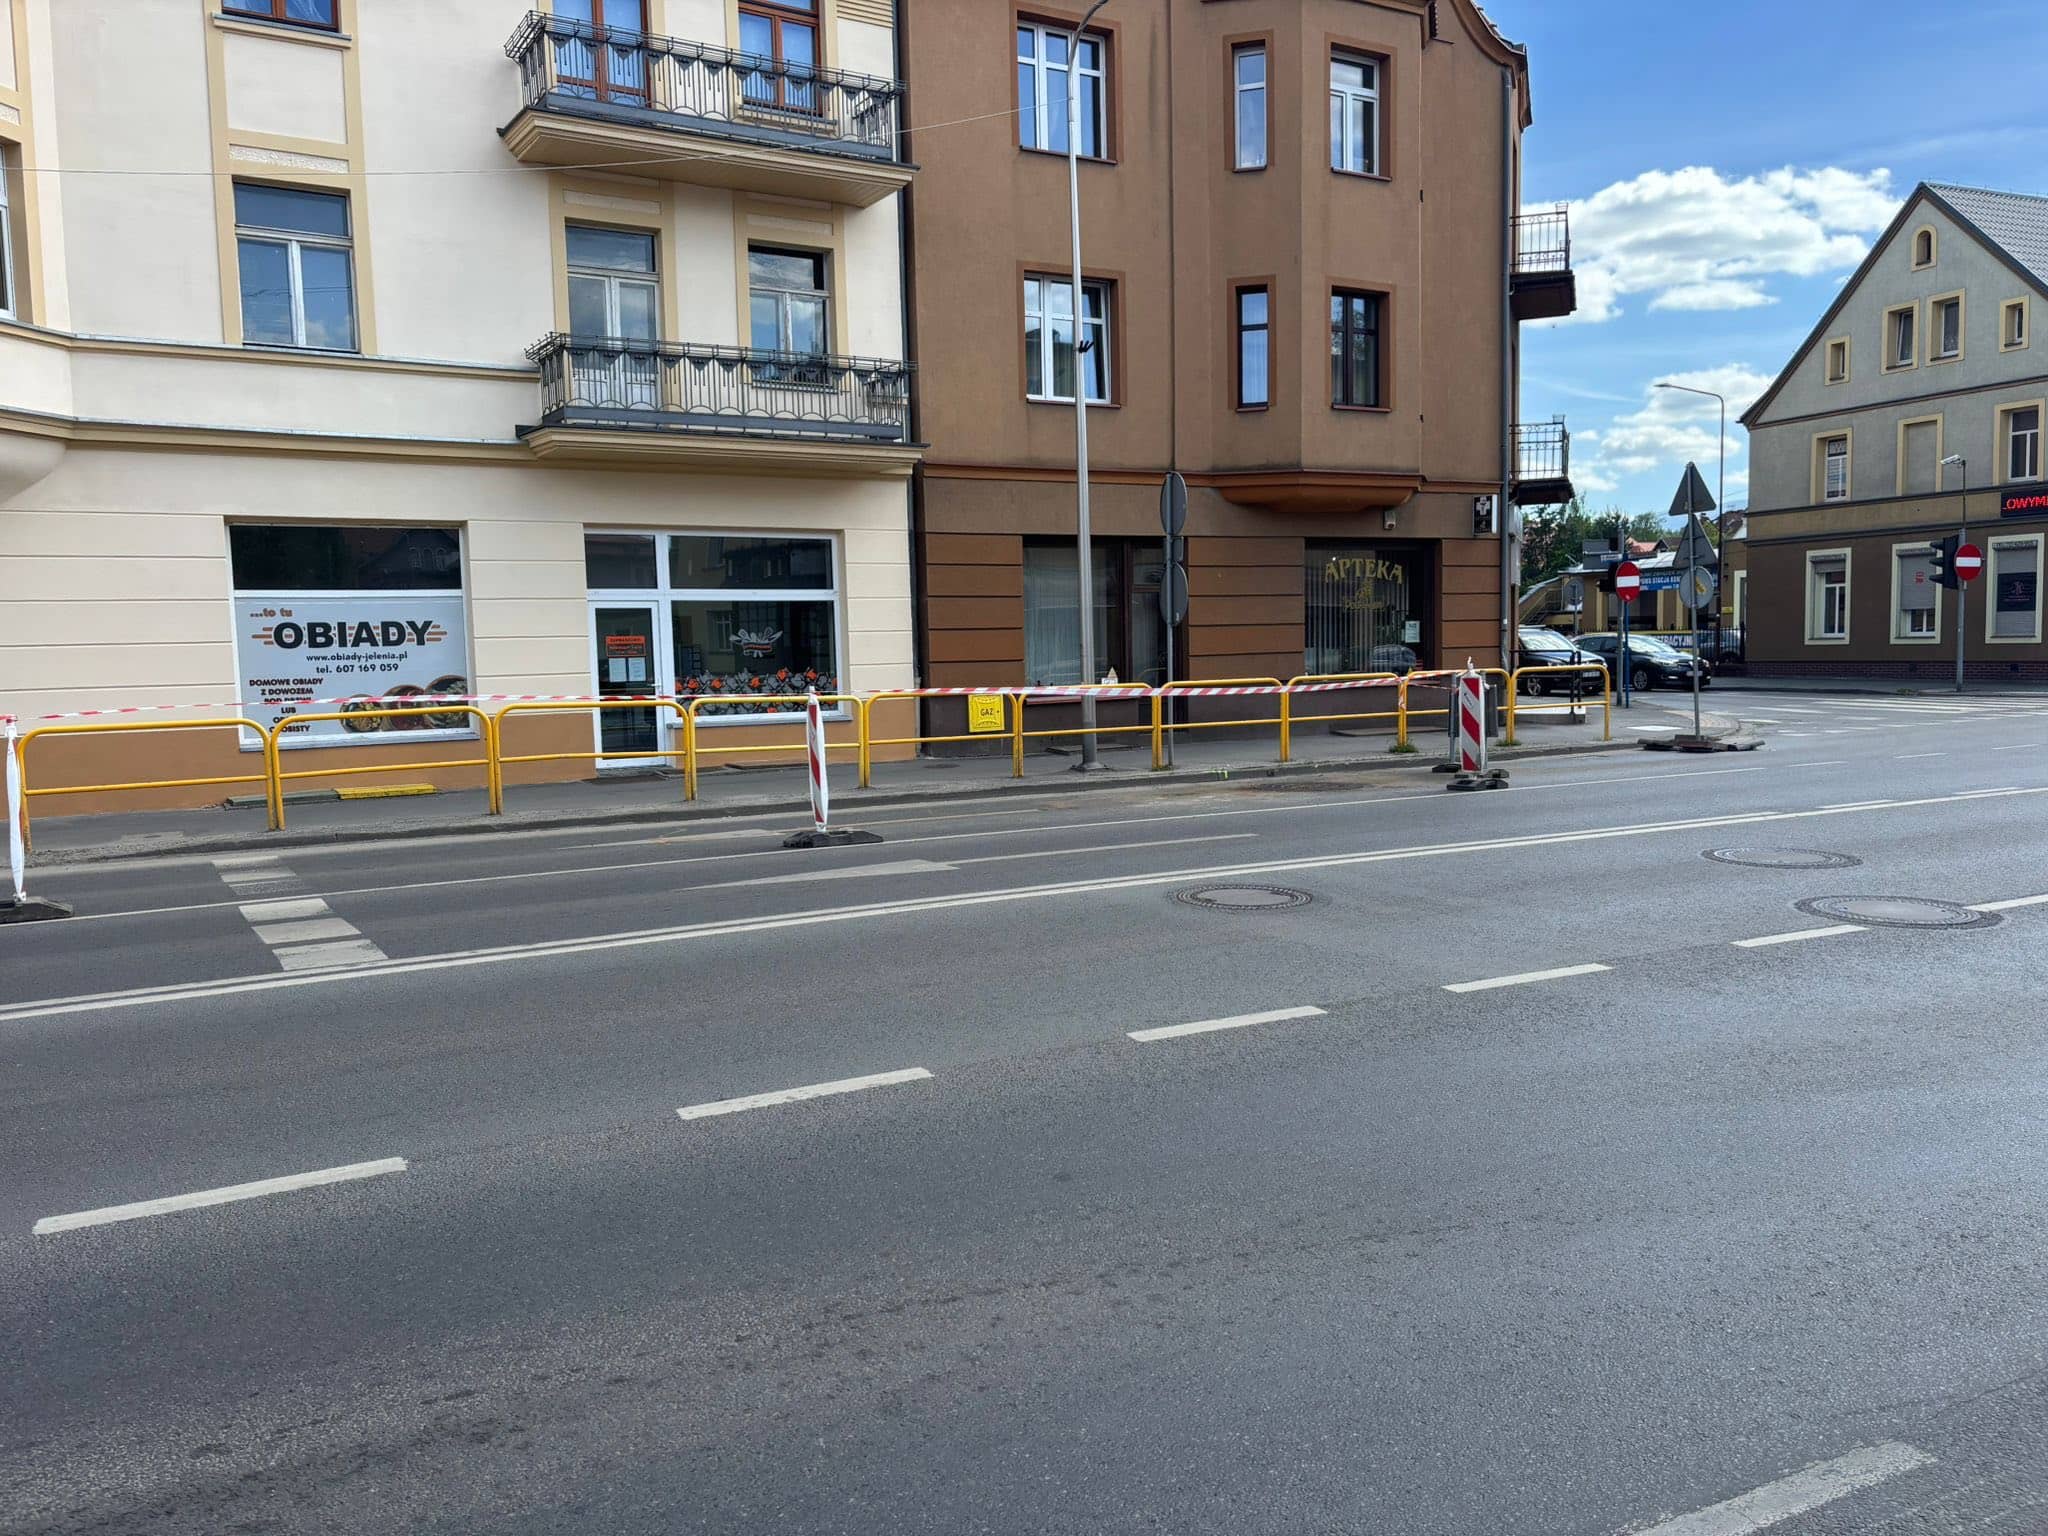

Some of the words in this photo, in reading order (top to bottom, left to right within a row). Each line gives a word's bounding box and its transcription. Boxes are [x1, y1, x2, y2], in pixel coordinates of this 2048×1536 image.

[1325, 558, 1403, 584] APTEKA
[280, 608, 293, 617] tu
[274, 620, 433, 649] OBIADY
[306, 651, 408, 662] www.obiady-jelenia.pl
[316, 664, 332, 673] tel.
[336, 664, 355, 673] 607
[358, 664, 376, 672] 169
[380, 663, 399, 672] 059
[980, 708, 994, 717] GAZ
[269, 725, 311, 733] OOBISTY
